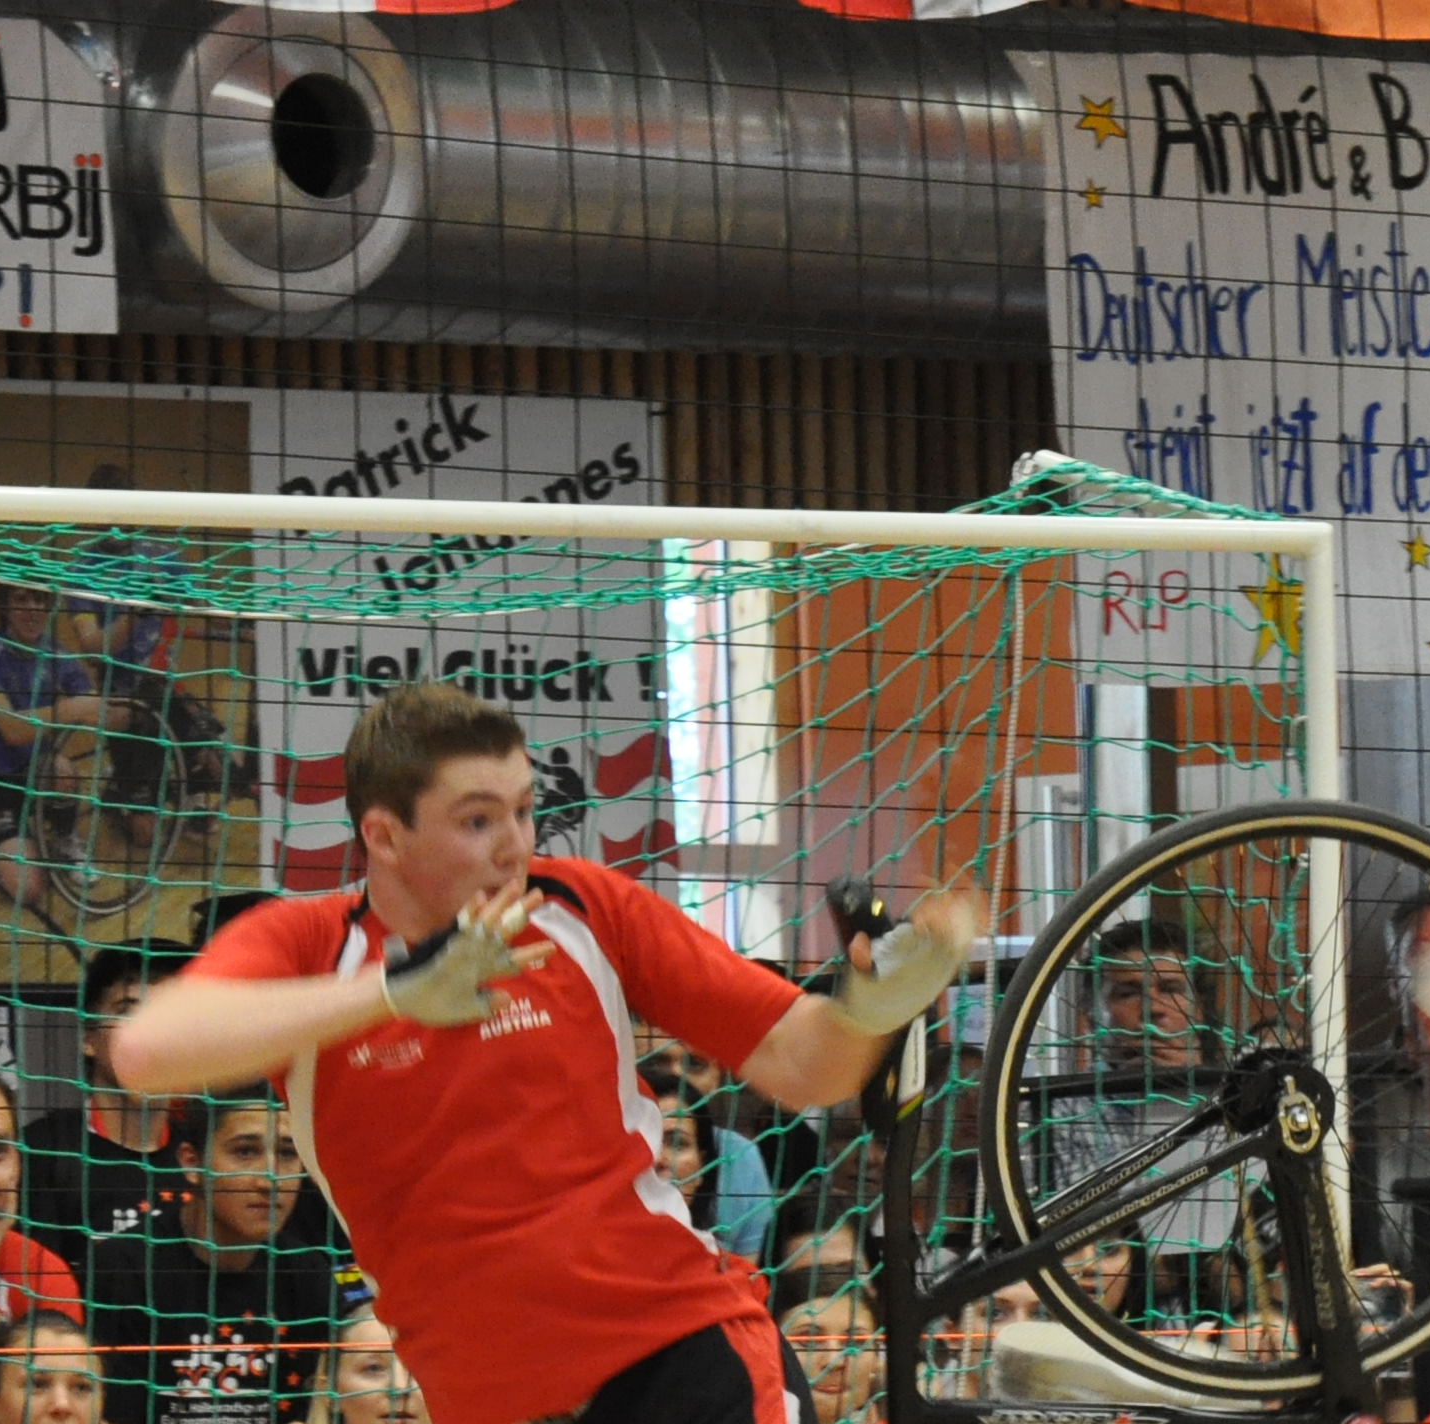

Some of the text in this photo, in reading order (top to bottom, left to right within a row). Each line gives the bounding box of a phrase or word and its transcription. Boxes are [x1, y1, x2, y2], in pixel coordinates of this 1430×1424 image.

[1147, 74, 1336, 198] André
[1348, 144, 1372, 199] &
[373, 441, 642, 613] Johnes
[300, 647, 420, 698] Viel
[442, 645, 615, 702] Glück
[479, 1010, 553, 1042] AUSTRIA
